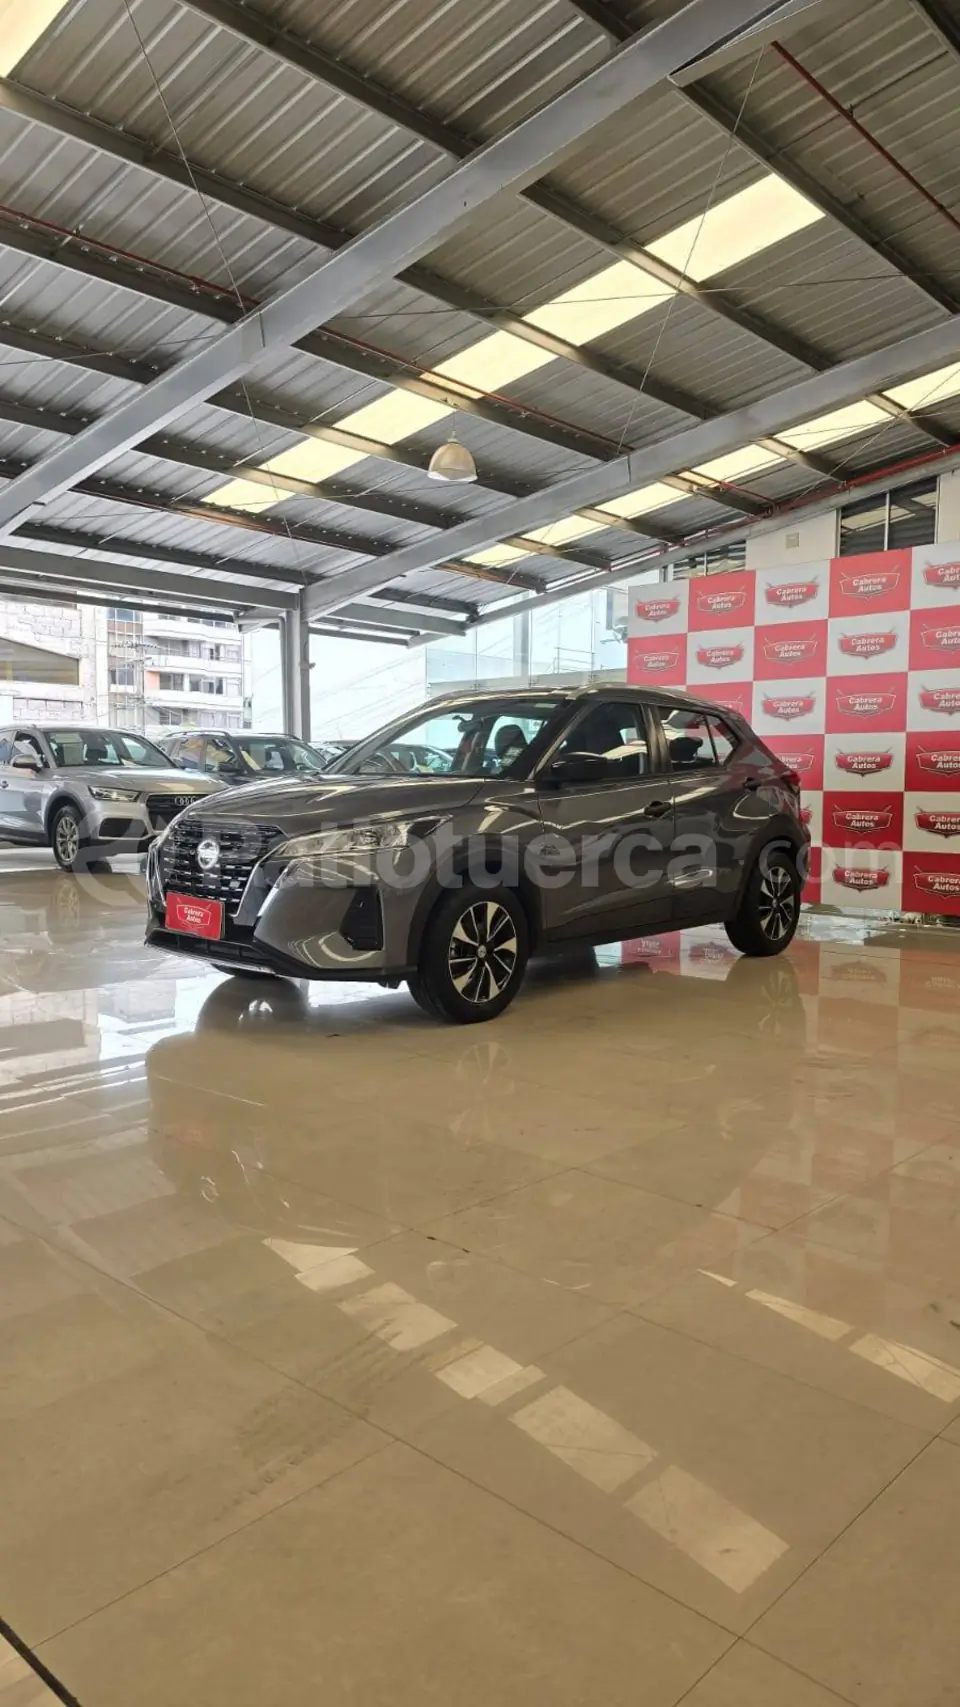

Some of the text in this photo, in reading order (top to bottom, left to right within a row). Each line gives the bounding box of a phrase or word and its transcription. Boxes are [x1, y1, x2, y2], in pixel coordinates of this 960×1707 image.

[938, 567, 960, 575] Cabr
[852, 576, 887, 587] Cabrera
[943, 574, 960, 582] Aut
[776, 587, 807, 596] Cabrera
[858, 585, 882, 593] Autos
[707, 596, 736, 604] Cabrera
[781, 594, 803, 602] Autos
[711, 602, 732, 610] Autos
[851, 636, 885, 646] Cabrera
[774, 644, 805, 653] Cabrera
[856, 643, 880, 652] Autos
[779, 650, 801, 658] Autos
[848, 696, 883, 704] Cabrera
[933, 692, 960, 701] Cabre
[772, 700, 804, 708] Cabrera
[854, 703, 878, 711] Autos
[938, 699, 960, 708] Auto
[847, 755, 881, 763] Cabrera
[845, 813, 879, 821] Cabrera
[850, 820, 875, 828] Autos
[844, 870, 878, 878] Cabrera
[849, 877, 874, 885] Autos
